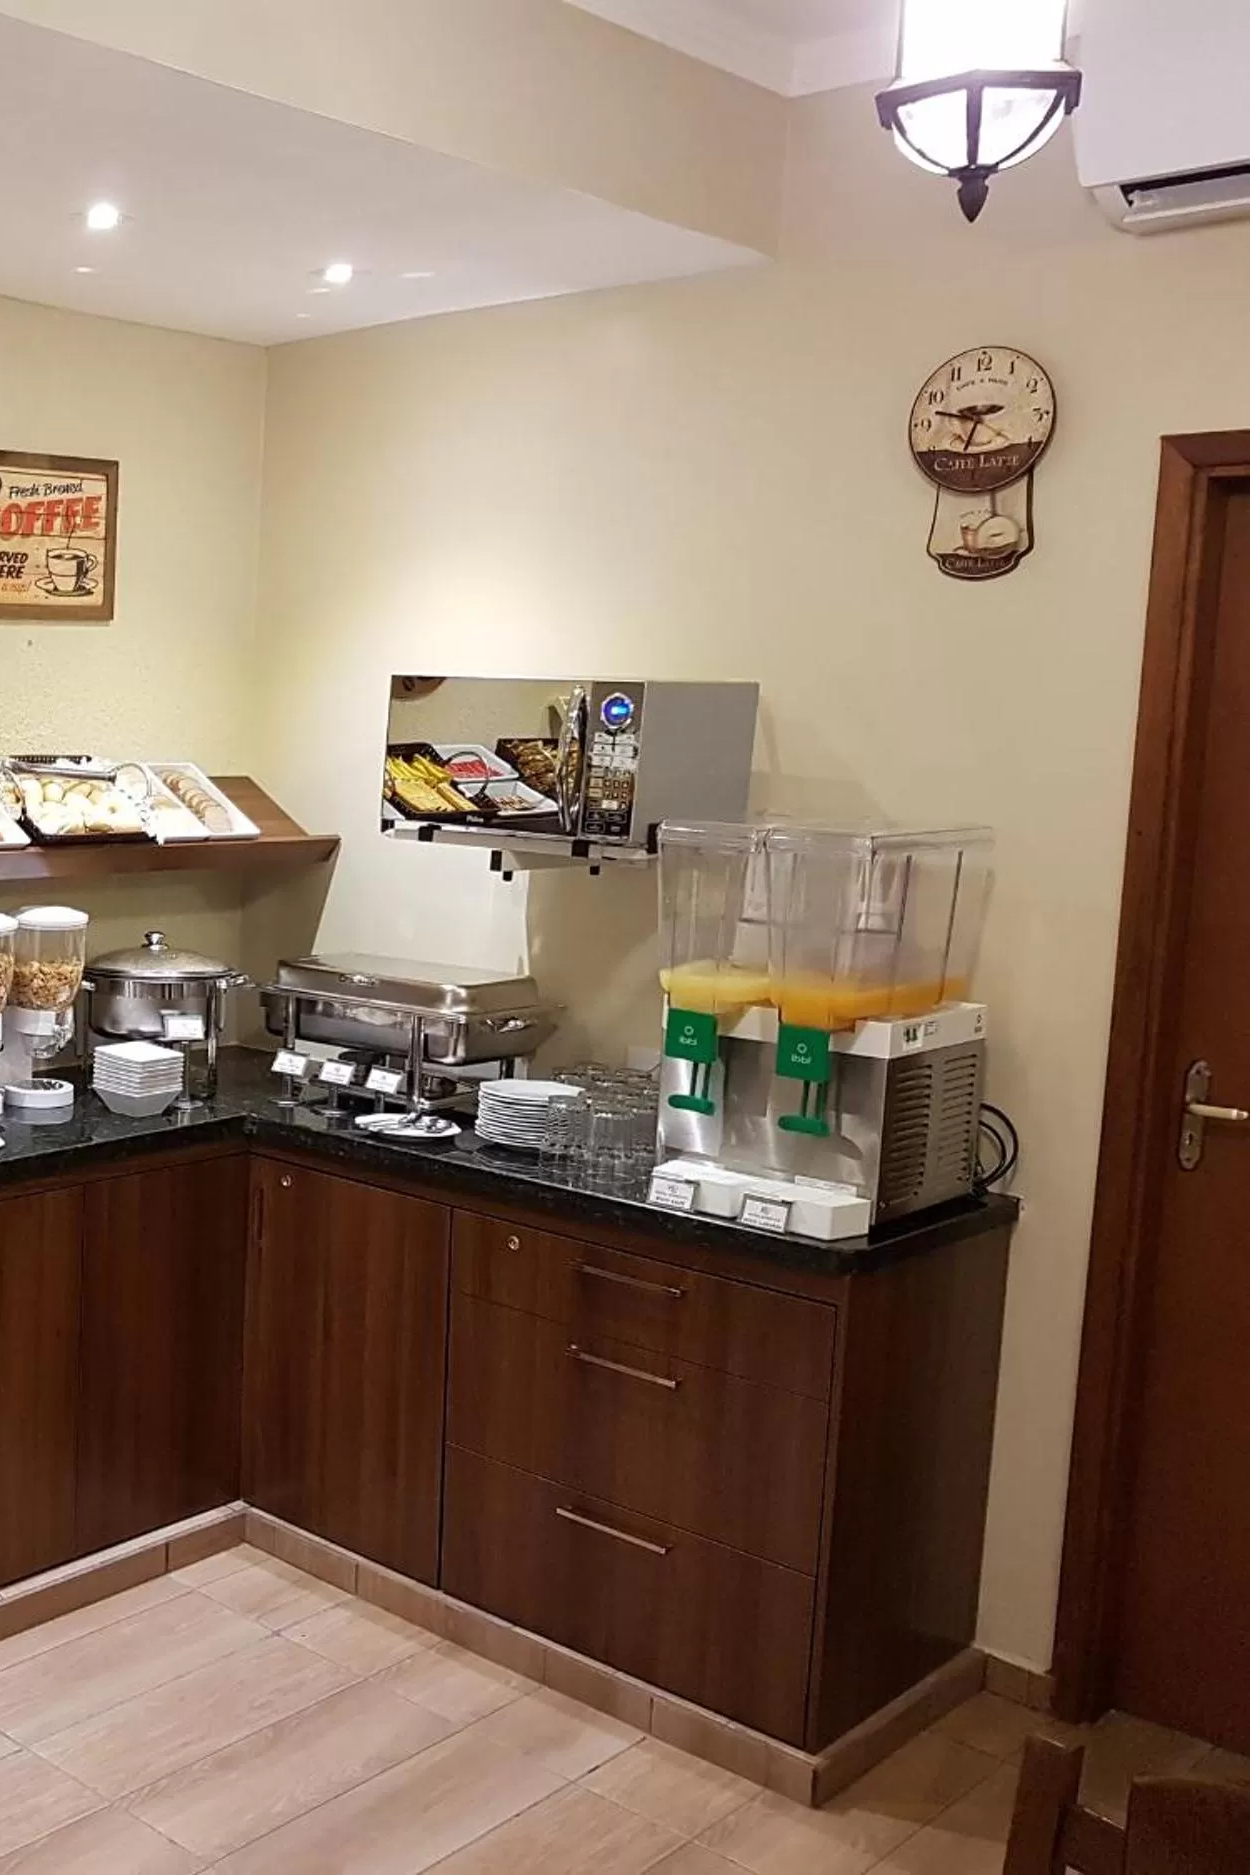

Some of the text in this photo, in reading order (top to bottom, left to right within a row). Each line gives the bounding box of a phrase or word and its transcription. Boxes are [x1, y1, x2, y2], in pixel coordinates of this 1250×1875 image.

[976, 355, 993, 372] 12
[951, 366, 962, 382] 11
[1026, 378, 1039, 393] 2
[928, 390, 944, 405] 10
